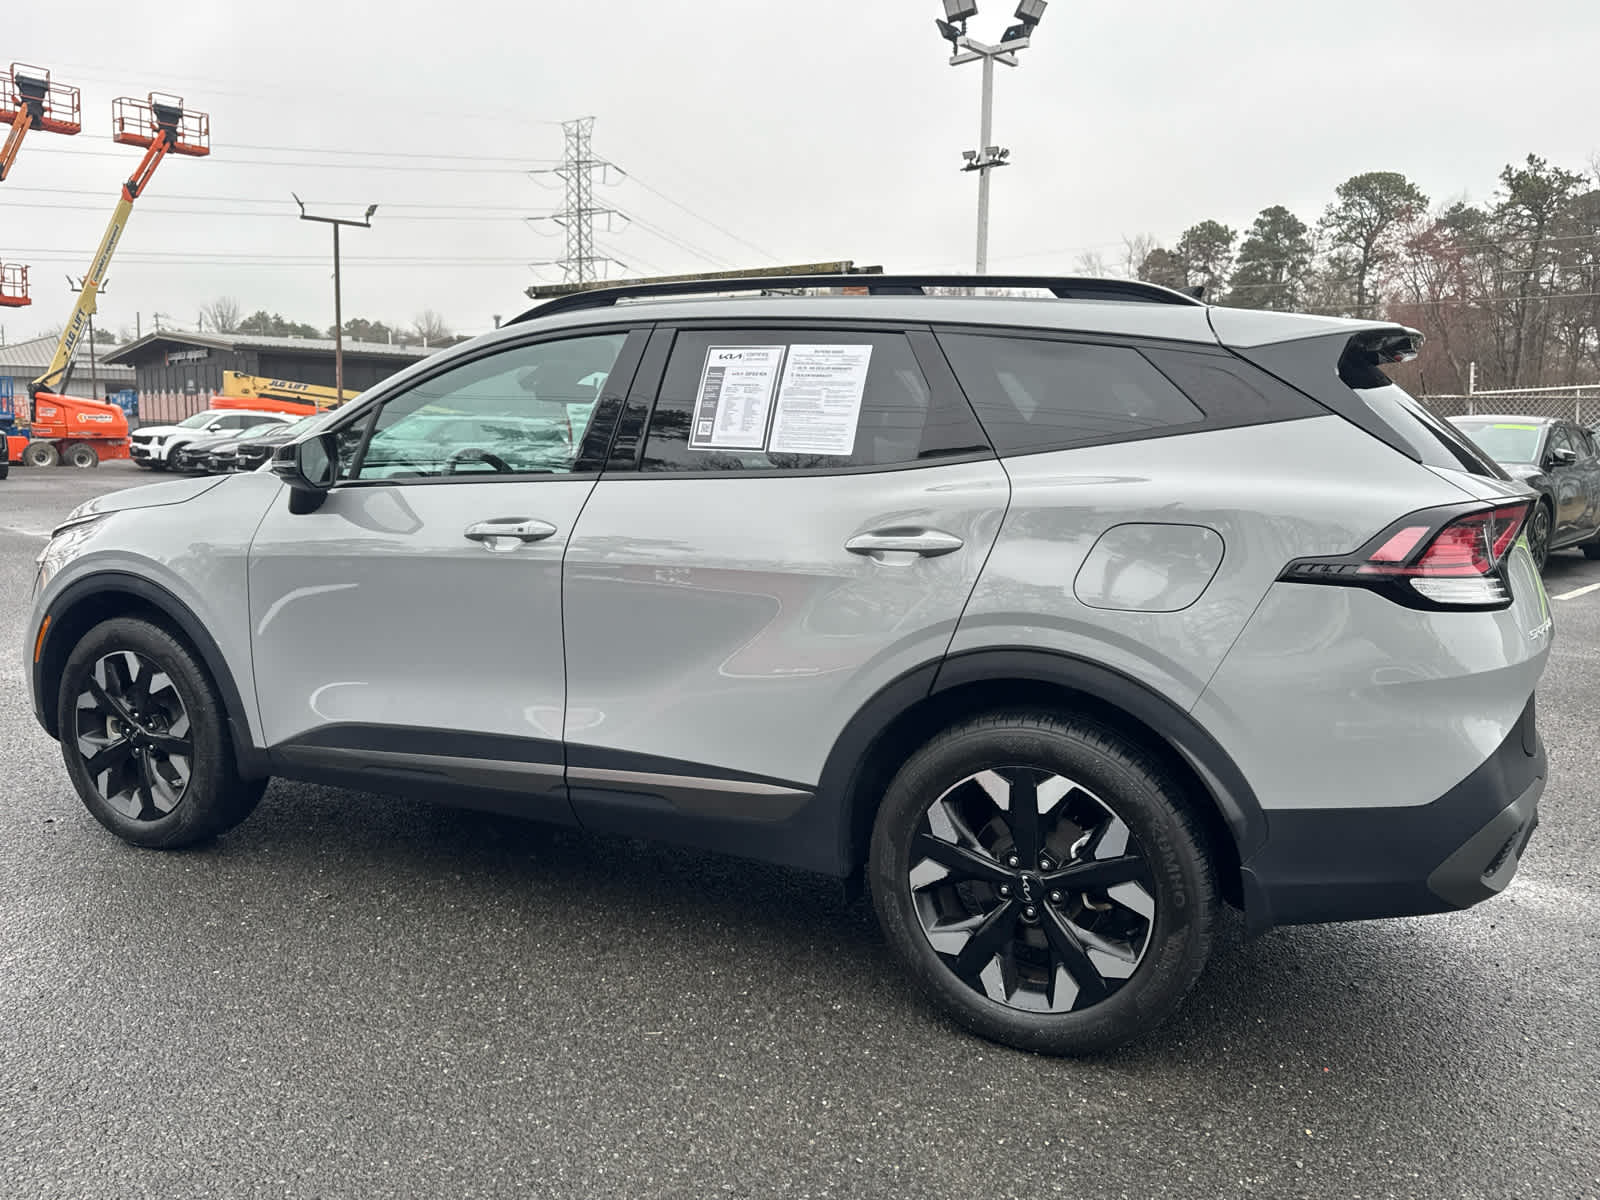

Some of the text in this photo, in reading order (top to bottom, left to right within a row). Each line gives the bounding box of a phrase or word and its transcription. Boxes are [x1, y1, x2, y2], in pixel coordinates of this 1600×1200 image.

[65, 307, 85, 350] JLG LIFT
[271, 380, 308, 390] JLG LIFT
[1022, 875, 1032, 901] KIA
